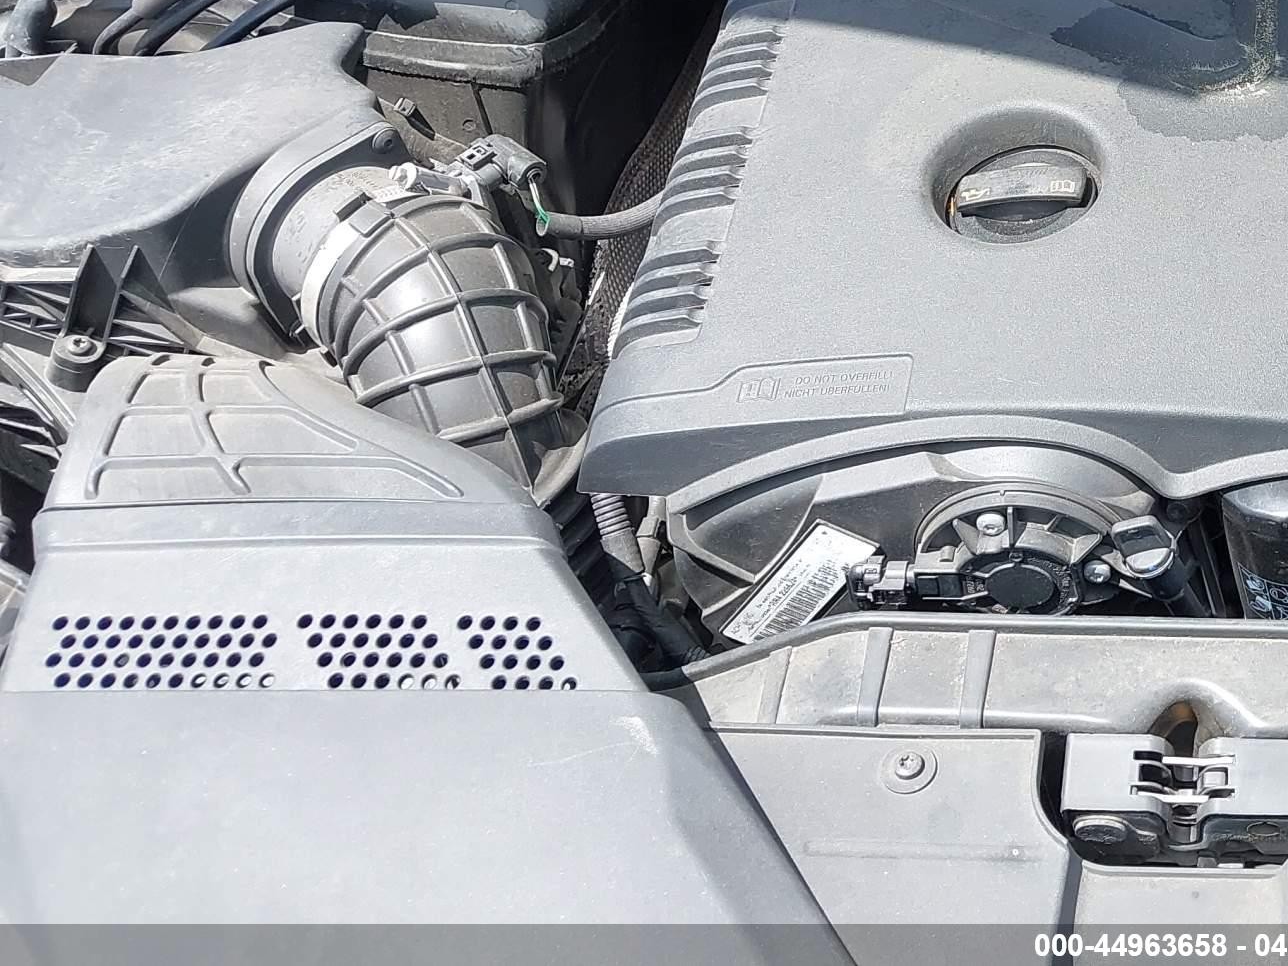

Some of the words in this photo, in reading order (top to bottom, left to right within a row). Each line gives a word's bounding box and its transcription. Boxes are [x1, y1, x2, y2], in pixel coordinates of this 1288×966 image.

[795, 376, 811, 385] DO
[814, 374, 836, 384] NOT
[784, 388, 815, 398] NICHT
